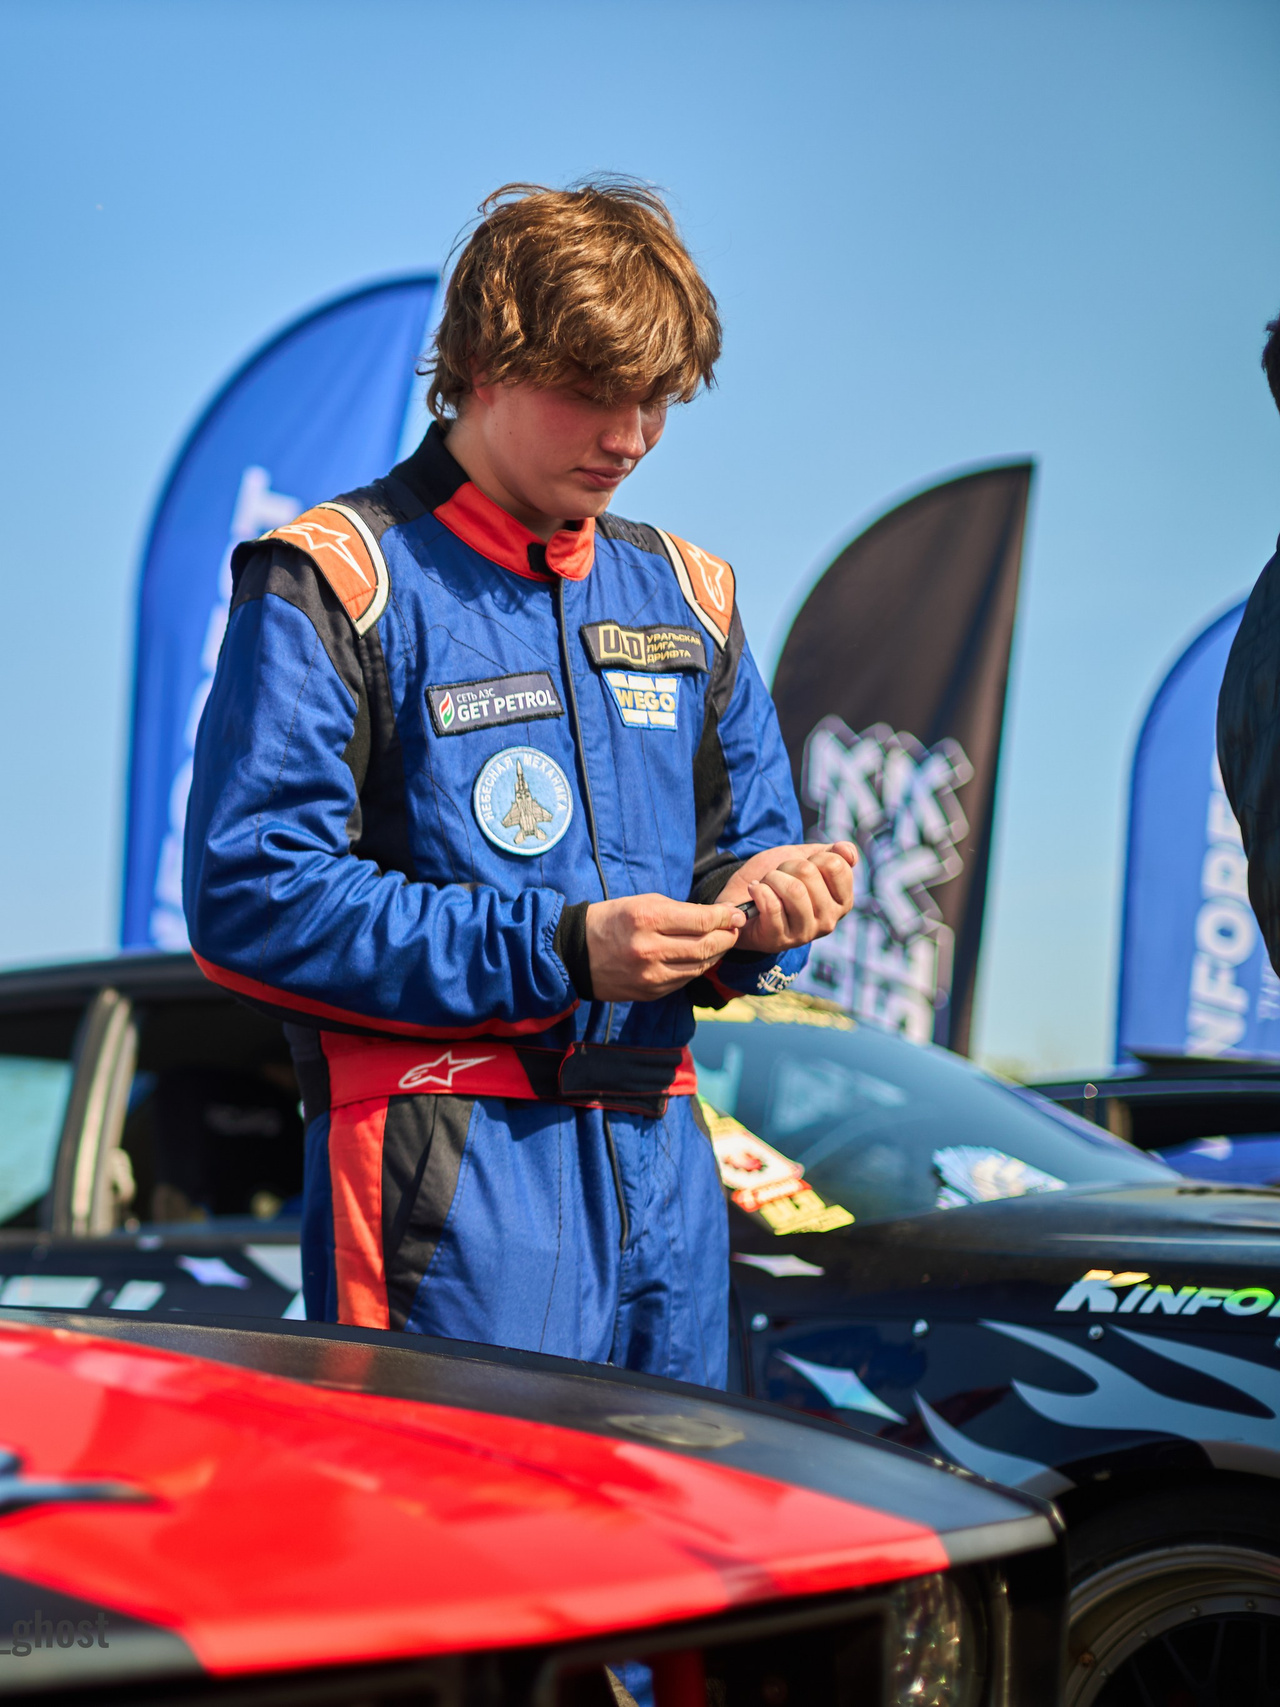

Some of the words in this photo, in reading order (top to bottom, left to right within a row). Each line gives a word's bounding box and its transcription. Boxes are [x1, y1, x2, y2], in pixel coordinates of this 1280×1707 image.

[646, 632, 701, 646] УРАЛЬСКАЯ
[646, 641, 676, 653] ЛИГА
[646, 649, 691, 664] ДРИФТА
[456, 691, 478, 704] СЕТЬ
[479, 687, 496, 699] АЗС
[457, 699, 490, 722] GET
[493, 689, 557, 715] PETROL
[613, 688, 676, 712] WEGO
[480, 755, 514, 821] НЕБЕСНАЯ
[523, 753, 568, 811] МЕХАНИКА
[1054, 1269, 1280, 1318] KINFO
